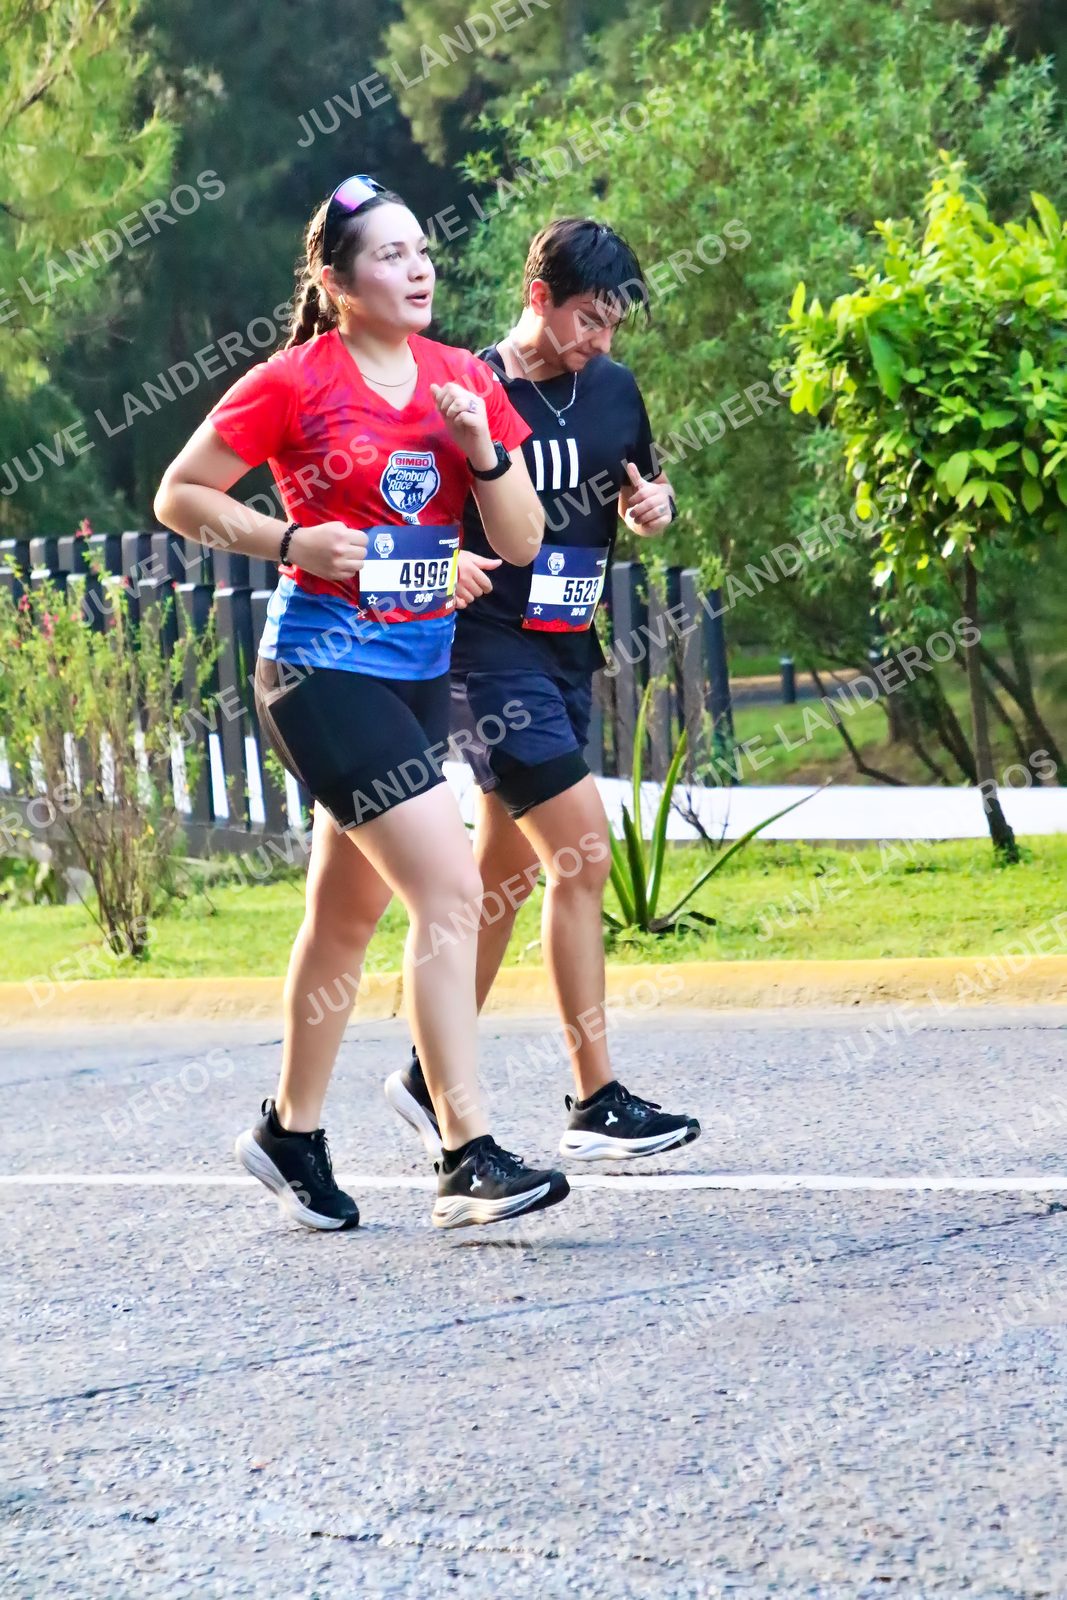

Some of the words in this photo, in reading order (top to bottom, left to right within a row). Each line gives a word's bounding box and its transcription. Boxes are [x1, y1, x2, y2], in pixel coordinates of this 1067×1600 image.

[395, 457, 430, 467] BIMBO
[395, 469, 427, 482] Global
[388, 480, 413, 491] Race
[399, 560, 449, 588] 4996
[562, 579, 599, 603] 5523
